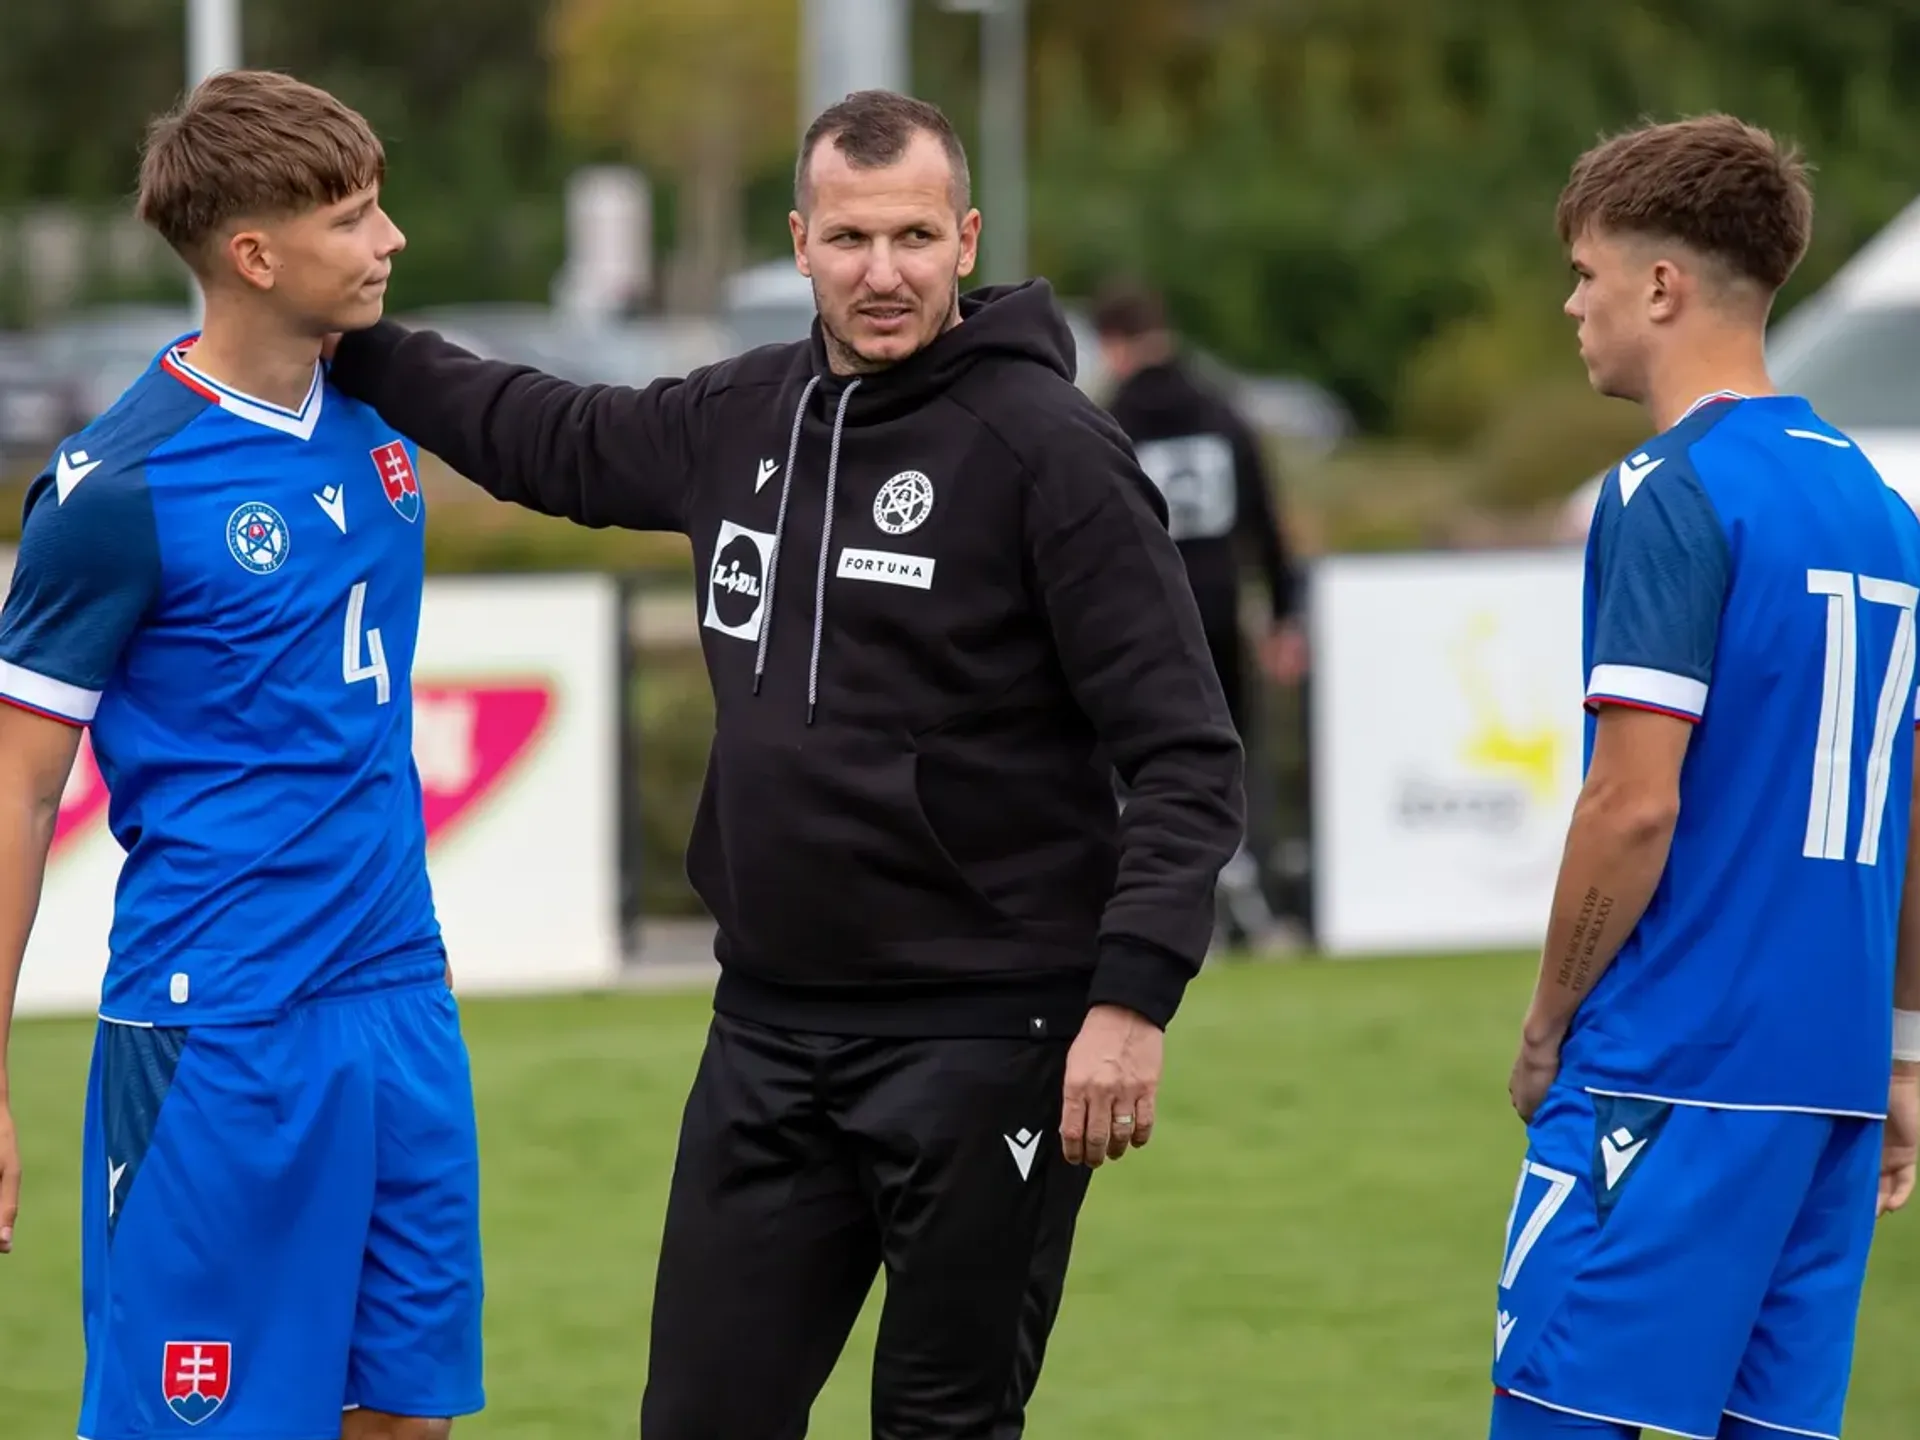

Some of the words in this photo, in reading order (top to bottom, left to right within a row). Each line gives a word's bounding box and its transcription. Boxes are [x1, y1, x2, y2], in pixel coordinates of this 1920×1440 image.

[845, 557, 922, 578] FORTUNA
[342, 581, 391, 705] 4
[1803, 568, 1920, 867] 17
